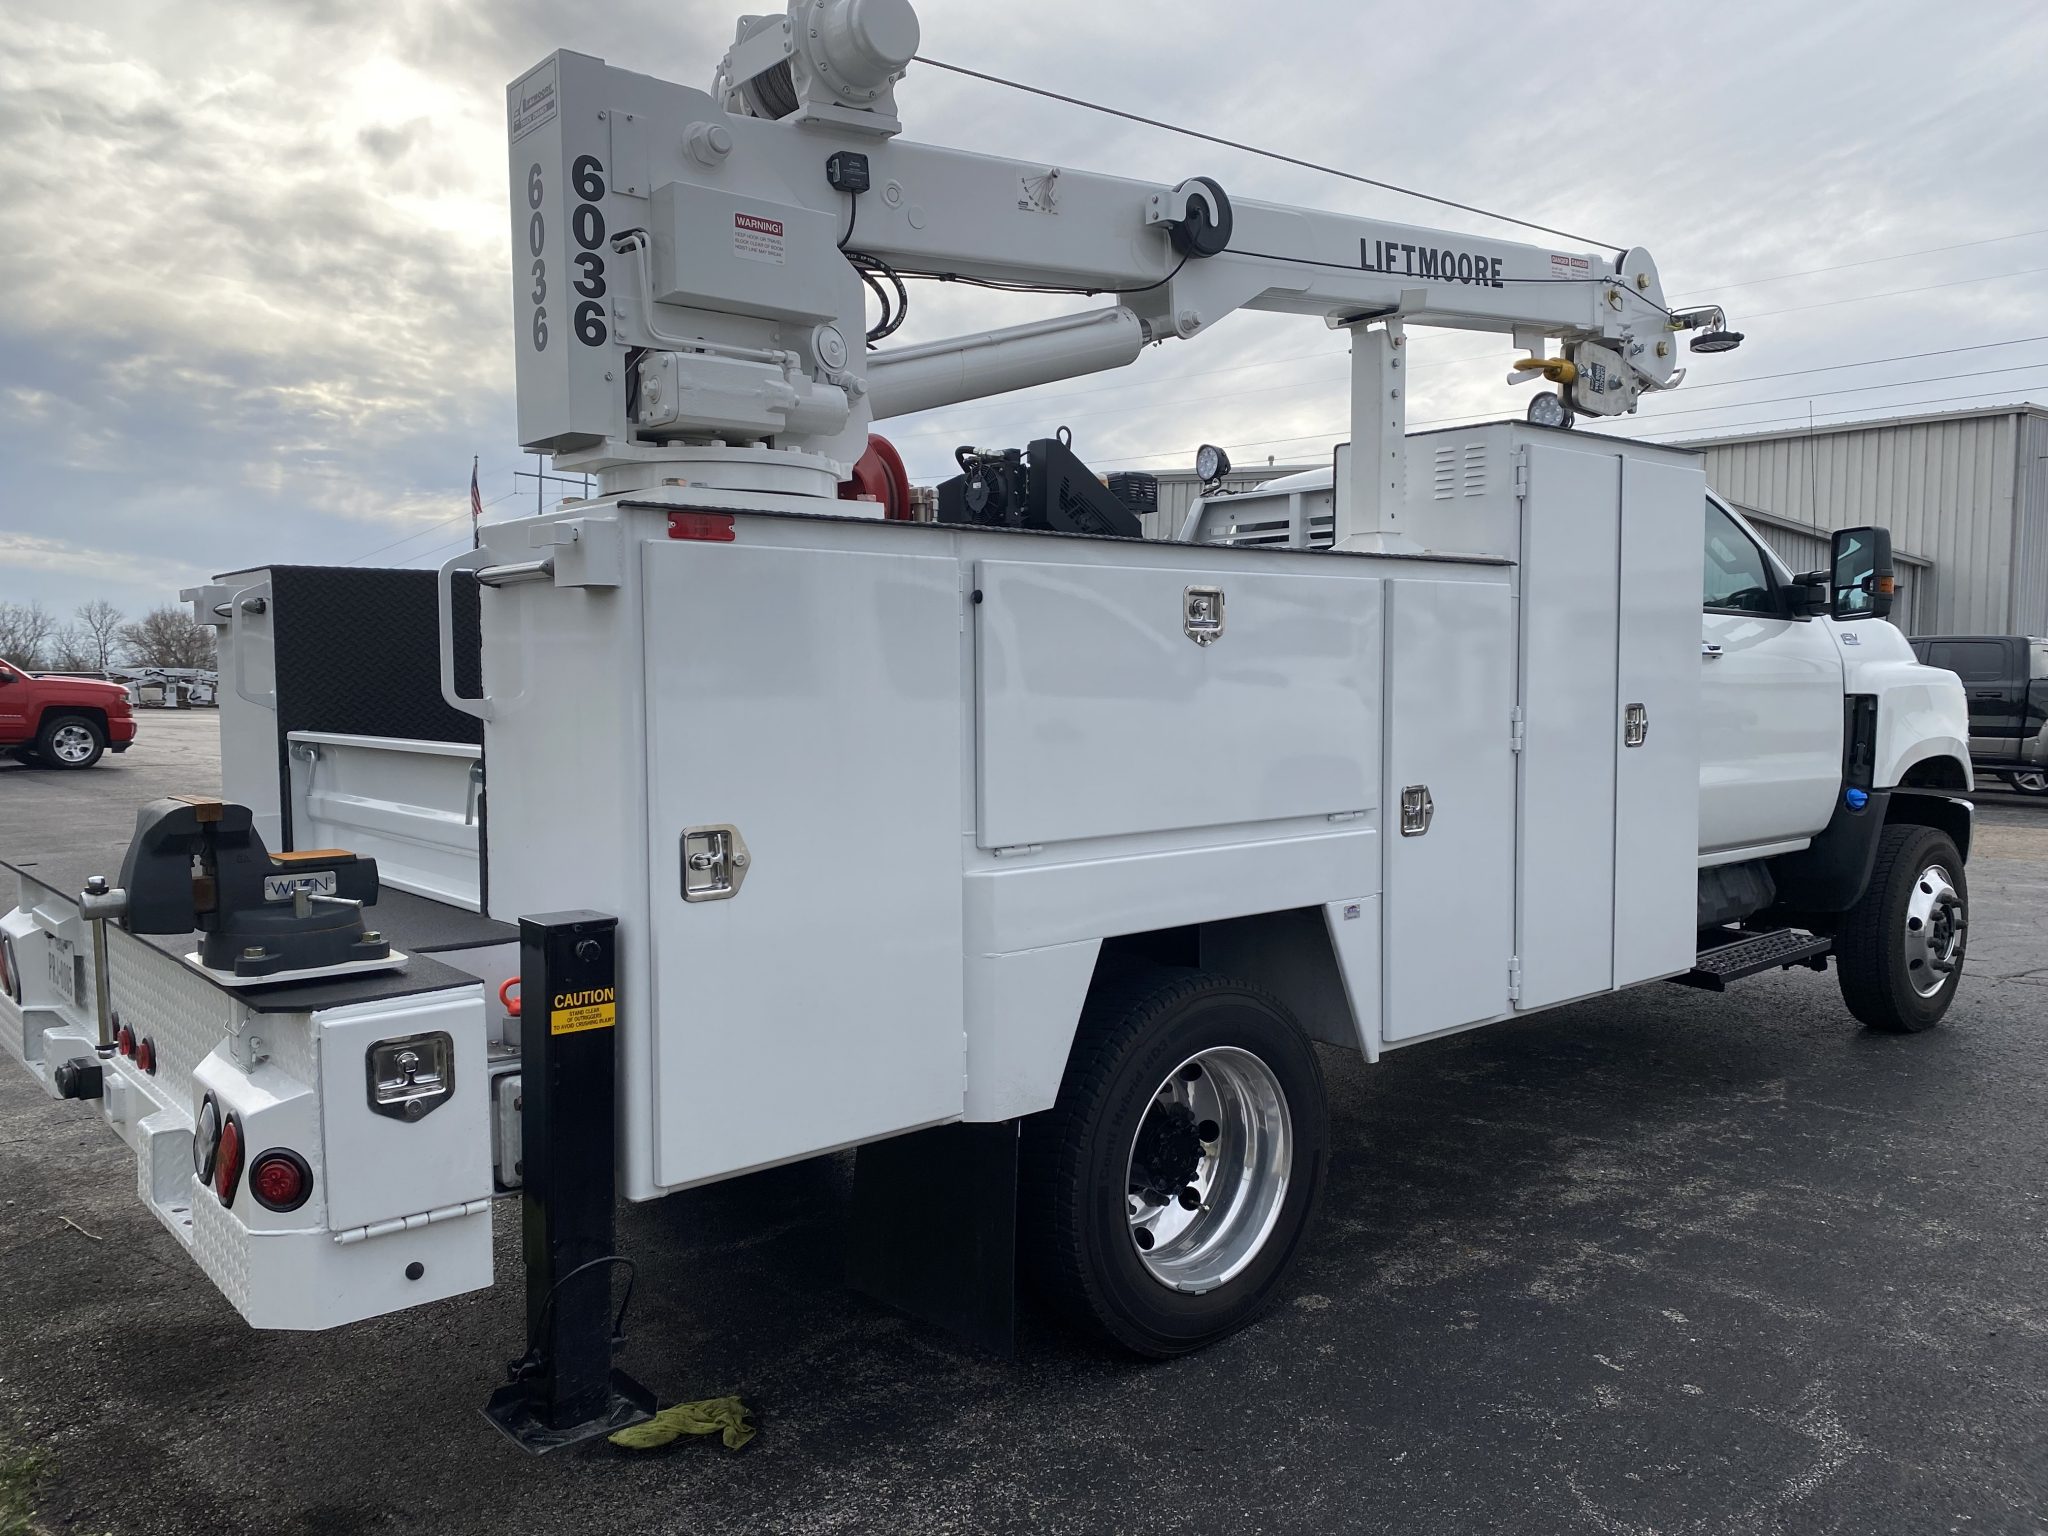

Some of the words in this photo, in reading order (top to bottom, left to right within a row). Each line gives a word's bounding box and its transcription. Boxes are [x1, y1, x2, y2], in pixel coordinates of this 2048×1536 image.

[737, 216, 782, 234] WARNING!
[528, 163, 548, 352] 6036
[572, 155, 607, 347] 6036
[1360, 238, 1504, 289] LIFTMOORE
[554, 988, 614, 1008] CAUTION
